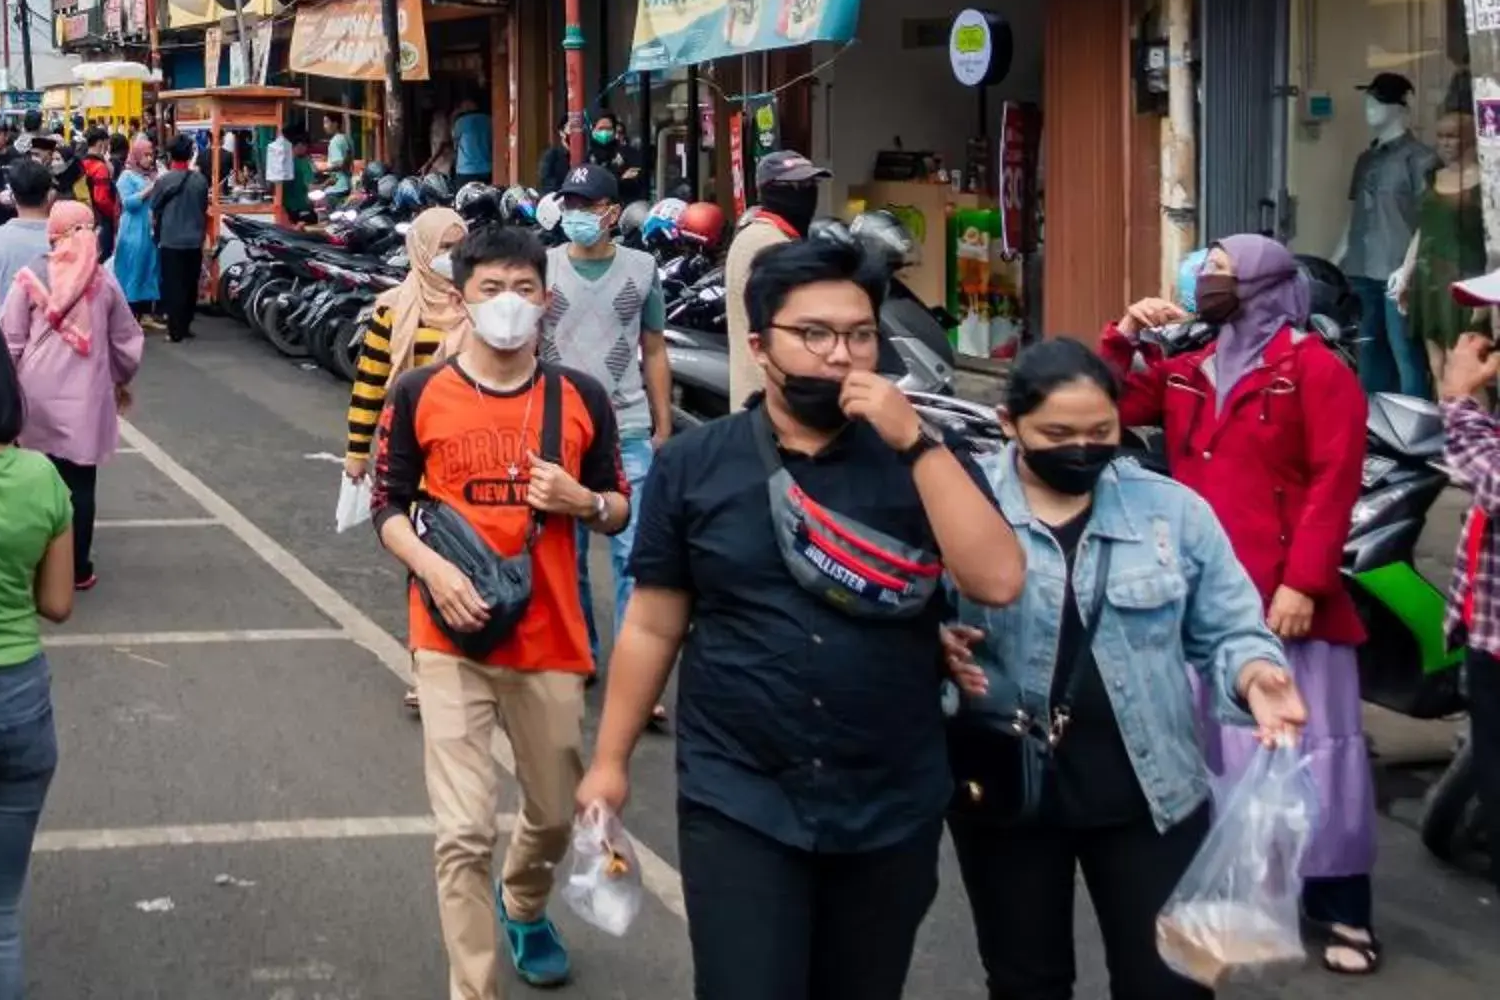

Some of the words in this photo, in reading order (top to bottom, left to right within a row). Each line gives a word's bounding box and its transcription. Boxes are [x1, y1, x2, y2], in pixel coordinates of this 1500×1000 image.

[443, 426, 581, 480] BRON
[473, 484, 509, 501] NEW
[803, 544, 867, 593] HOLLISTER
